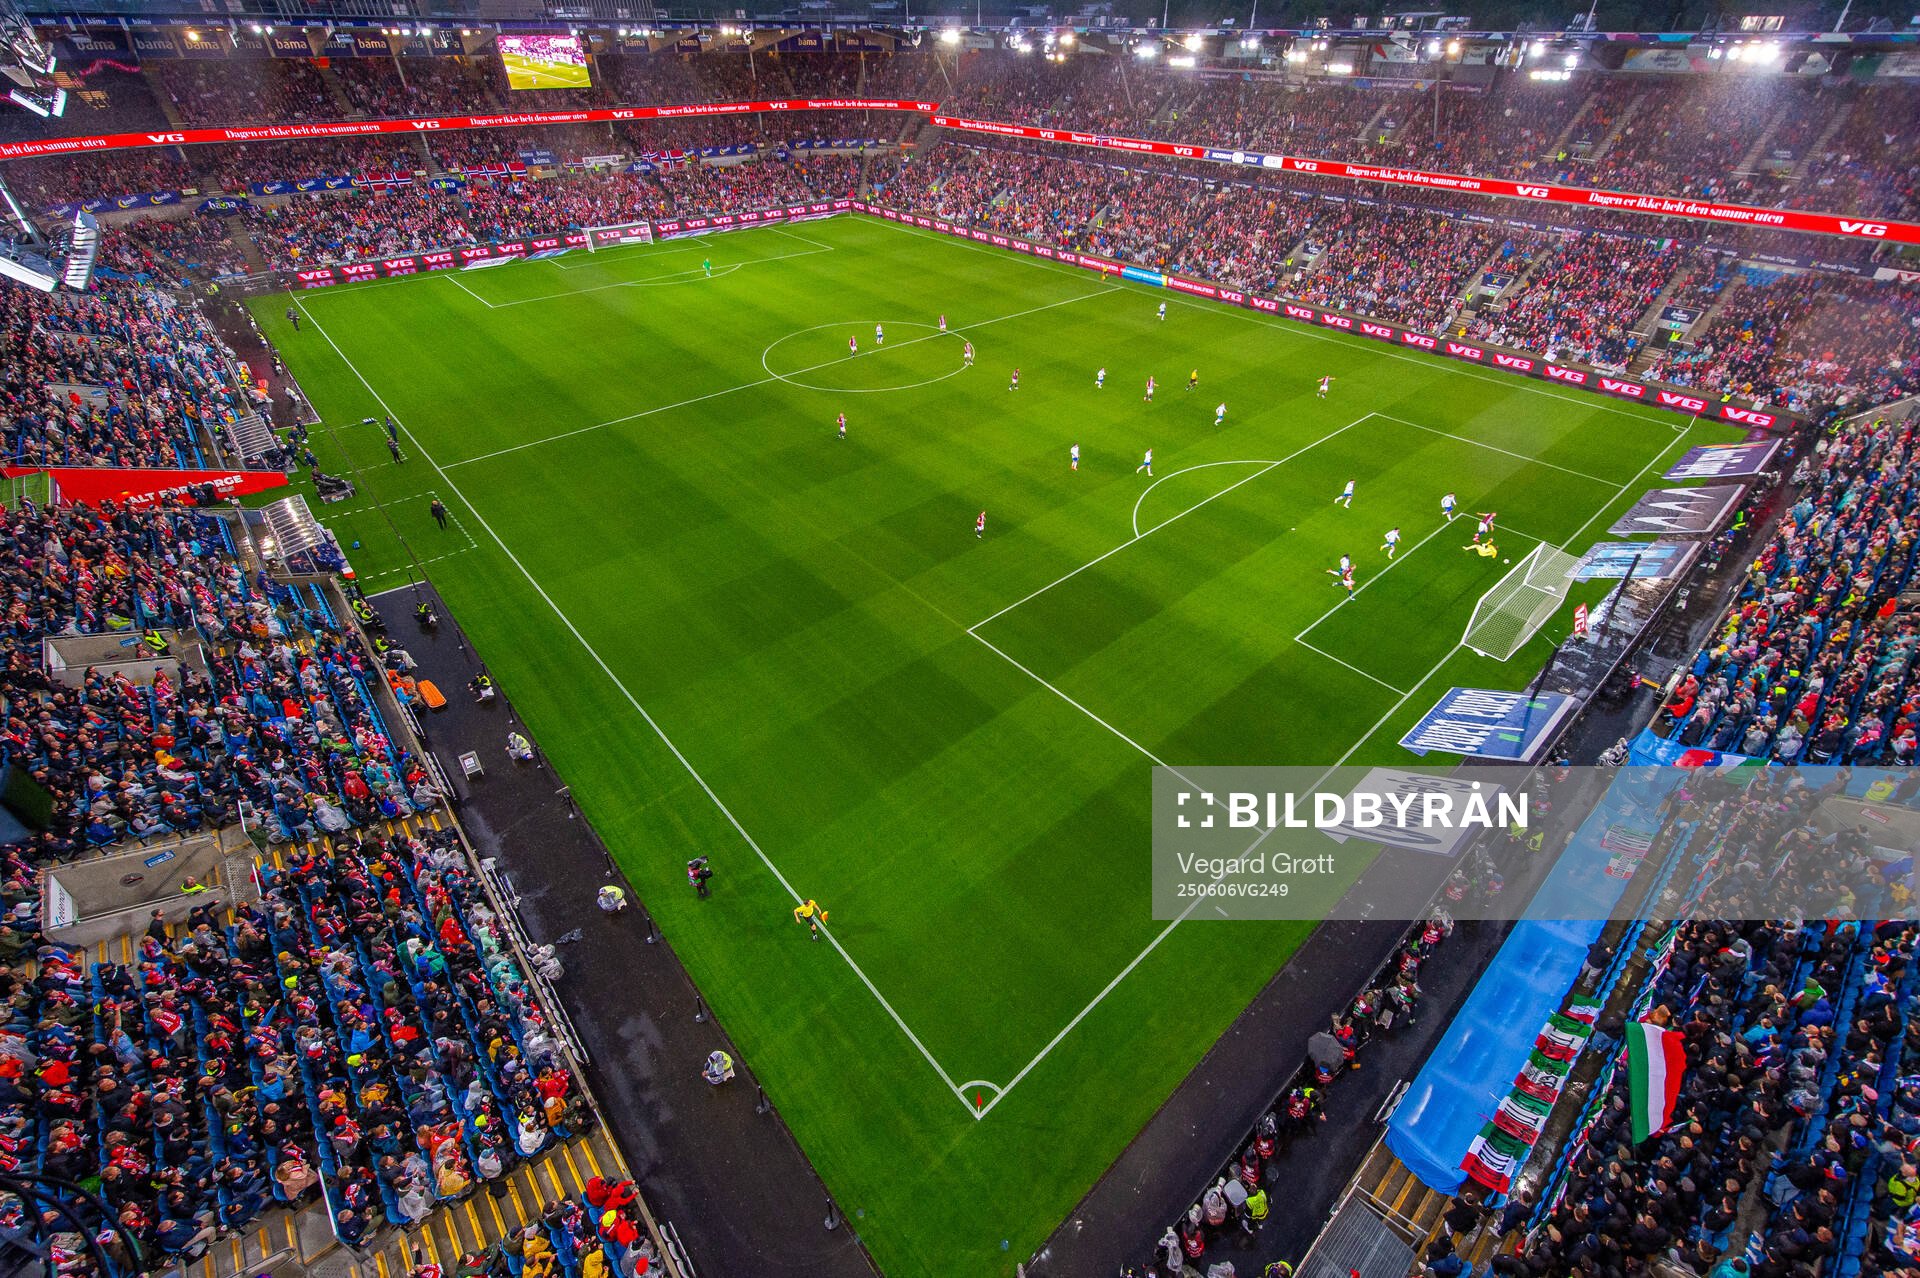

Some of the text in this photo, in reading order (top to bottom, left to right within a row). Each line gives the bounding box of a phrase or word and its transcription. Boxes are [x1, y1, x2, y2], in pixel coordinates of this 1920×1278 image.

[275, 39, 307, 50] bama
[358, 39, 386, 48] bama
[798, 38, 817, 46] bama
[147, 134, 184, 142] VG
[225, 130, 257, 140] Dagen
[270, 128, 290, 136] ikke
[292, 126, 310, 135] helt
[312, 126, 328, 134] den
[24, 144, 43, 153] den
[44, 141, 80, 151] samme
[82, 139, 106, 148] uten
[1174, 146, 1192, 156] VG
[1294, 160, 1318, 171] VG
[1346, 166, 1369, 177] Dagen
[1380, 167, 1396, 178] ikke
[1397, 169, 1412, 180] helt
[1414, 171, 1428, 182] den
[1430, 177, 1460, 188] samme
[1460, 179, 1480, 188] uten
[1516, 186, 1549, 198] VG
[854, 202, 865, 210] VG
[868, 206, 880, 214] VG
[1589, 192, 1784, 224] Dagen er ikke helt den samme uten
[884, 210, 896, 218] VG
[900, 214, 914, 222] VG
[687, 220, 706, 228] VG
[714, 216, 732, 224] VG
[918, 218, 930, 226] VG
[659, 224, 678, 232] VG
[934, 222, 949, 231] VG
[954, 226, 968, 236] VG
[1839, 220, 1888, 236] VG
[599, 231, 620, 239] VG
[630, 228, 650, 236] VG
[972, 231, 988, 240] VG
[534, 240, 558, 248] VG
[992, 236, 1008, 246] VG
[1013, 241, 1030, 250] VG
[462, 248, 490, 257] VG
[498, 244, 524, 252] VG
[1035, 246, 1052, 256] VG
[424, 254, 452, 262] VG
[1058, 252, 1076, 262] VG
[384, 260, 414, 268] VG
[343, 265, 374, 274] VG
[299, 271, 331, 280] VG
[1220, 290, 1244, 302] VG
[1252, 298, 1278, 310] VG
[1287, 306, 1313, 319] VG
[1323, 314, 1351, 328] VG
[1362, 324, 1392, 338] VG
[1403, 334, 1435, 348] VG
[1449, 344, 1482, 359] VG
[1496, 354, 1532, 370] VG
[1546, 366, 1585, 383] VG
[1601, 379, 1643, 396] VG
[1660, 392, 1705, 411] VG
[1725, 407, 1775, 427] VG
[129, 492, 156, 504] ALT
[1574, 605, 1585, 632] VG
[1414, 690, 1549, 751] bama bama
